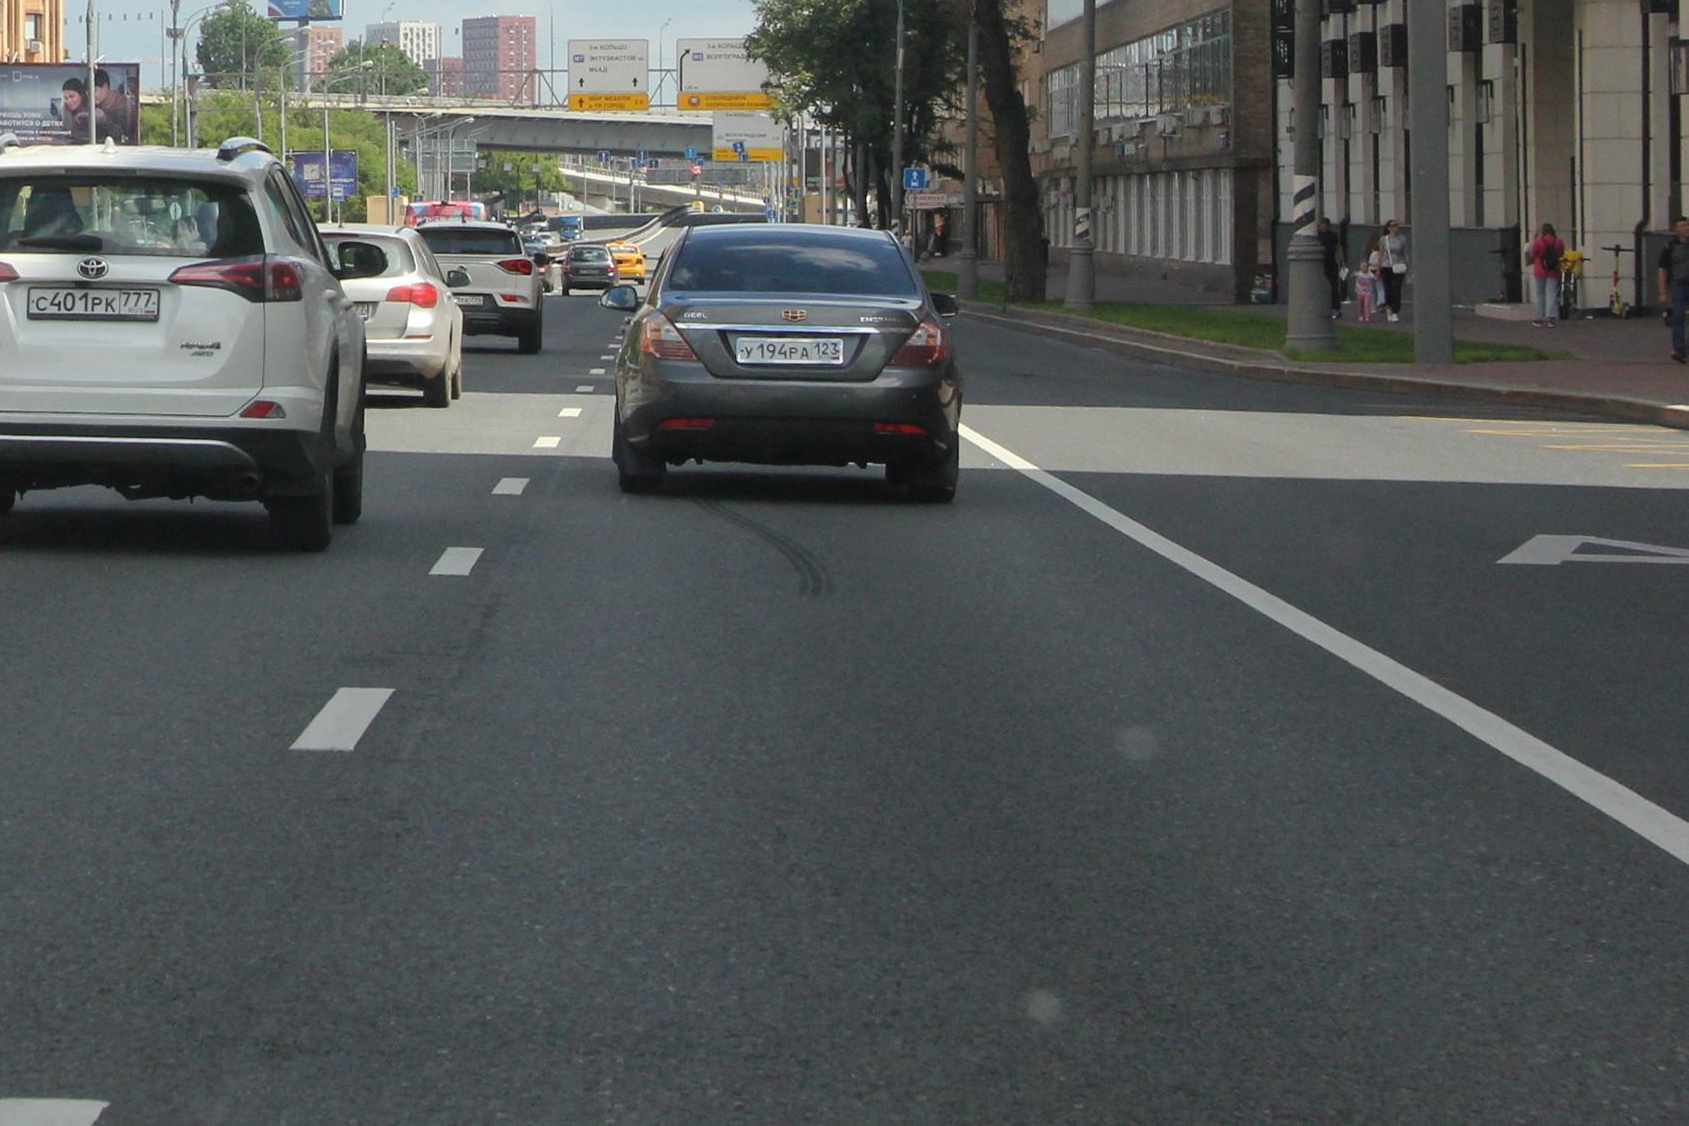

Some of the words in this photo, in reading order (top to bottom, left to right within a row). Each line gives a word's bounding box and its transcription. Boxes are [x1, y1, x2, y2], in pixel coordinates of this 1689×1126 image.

[35, 291, 116, 312] С401РК
[122, 291, 153, 308] 777
[814, 342, 838, 355] 123
